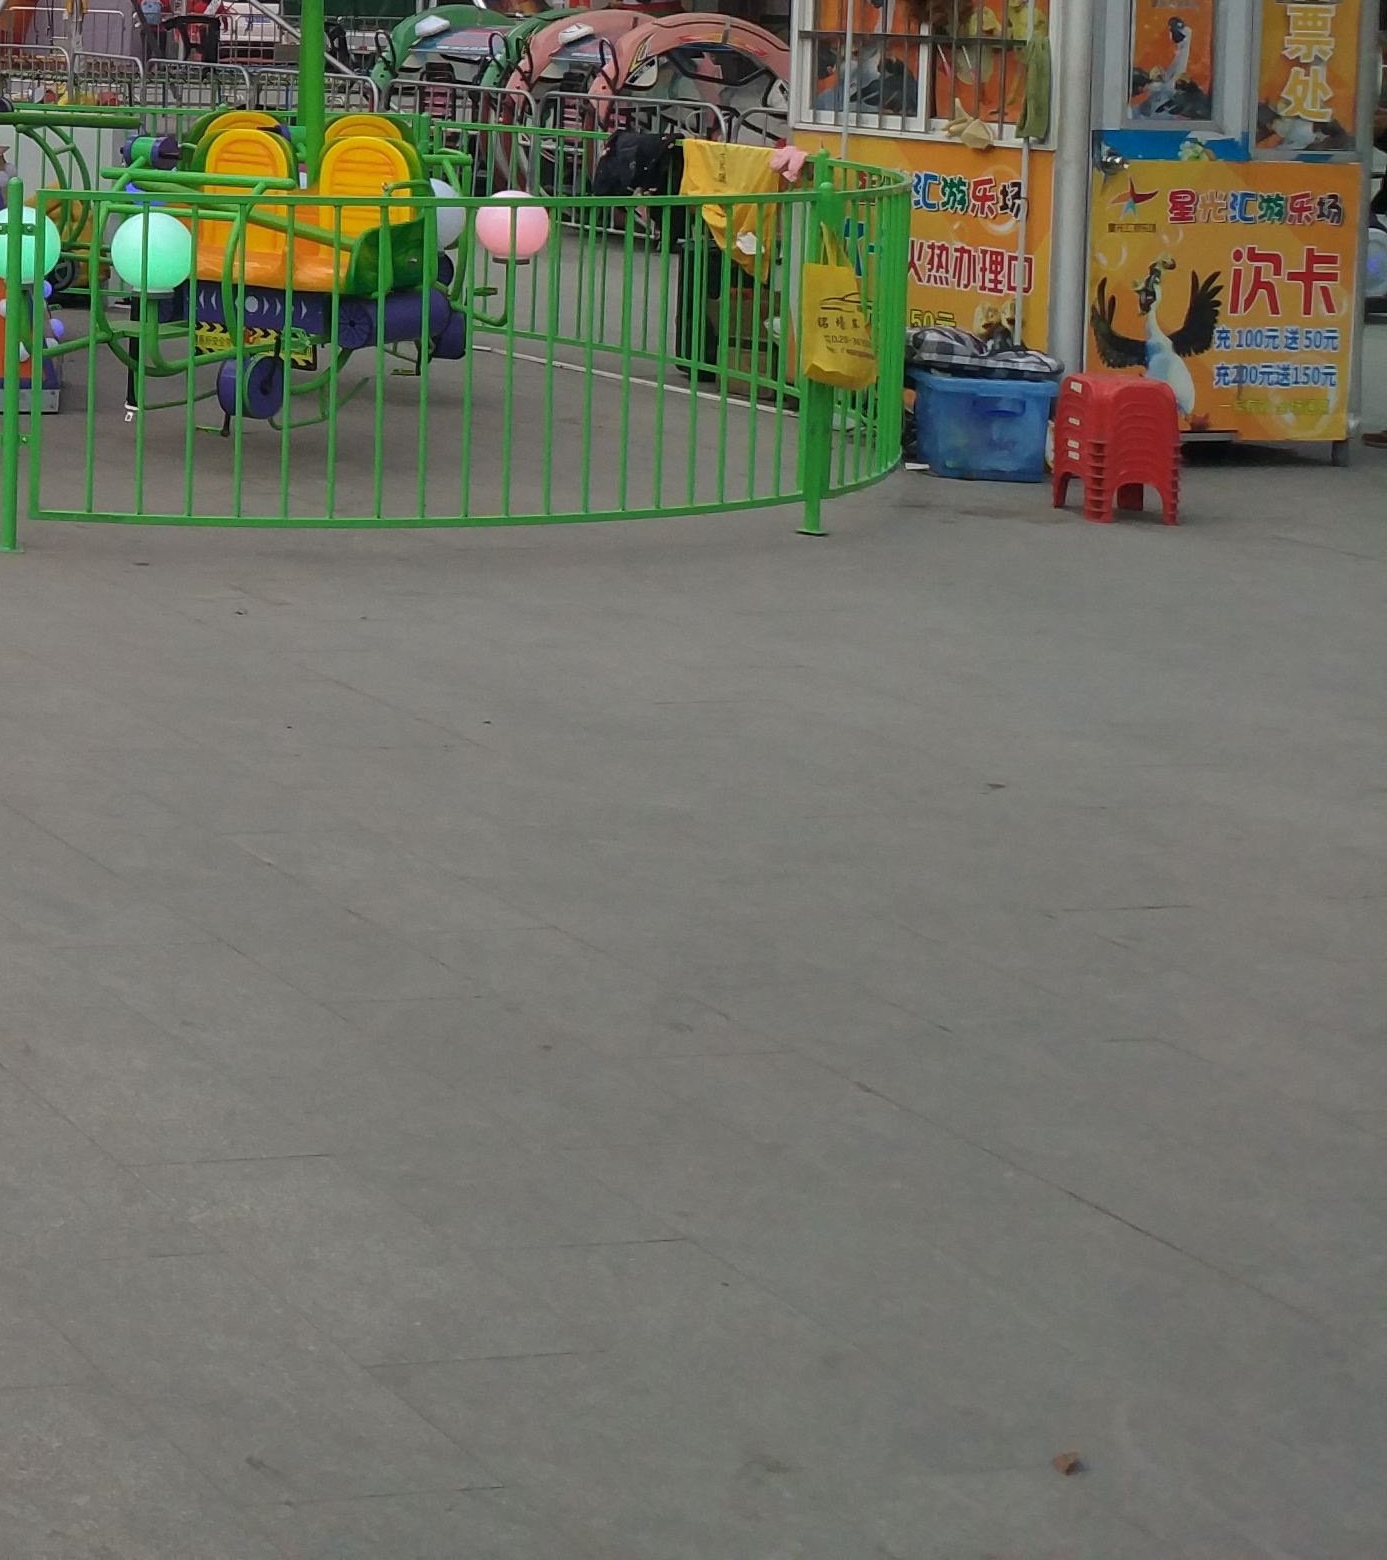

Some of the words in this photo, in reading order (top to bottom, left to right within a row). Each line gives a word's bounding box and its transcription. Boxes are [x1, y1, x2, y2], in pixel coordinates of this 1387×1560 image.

[1167, 188, 1343, 226] 星光汇游乐场
[1229, 245, 1340, 317] 次卡
[1214, 363, 1338, 388] 充200元送150元
